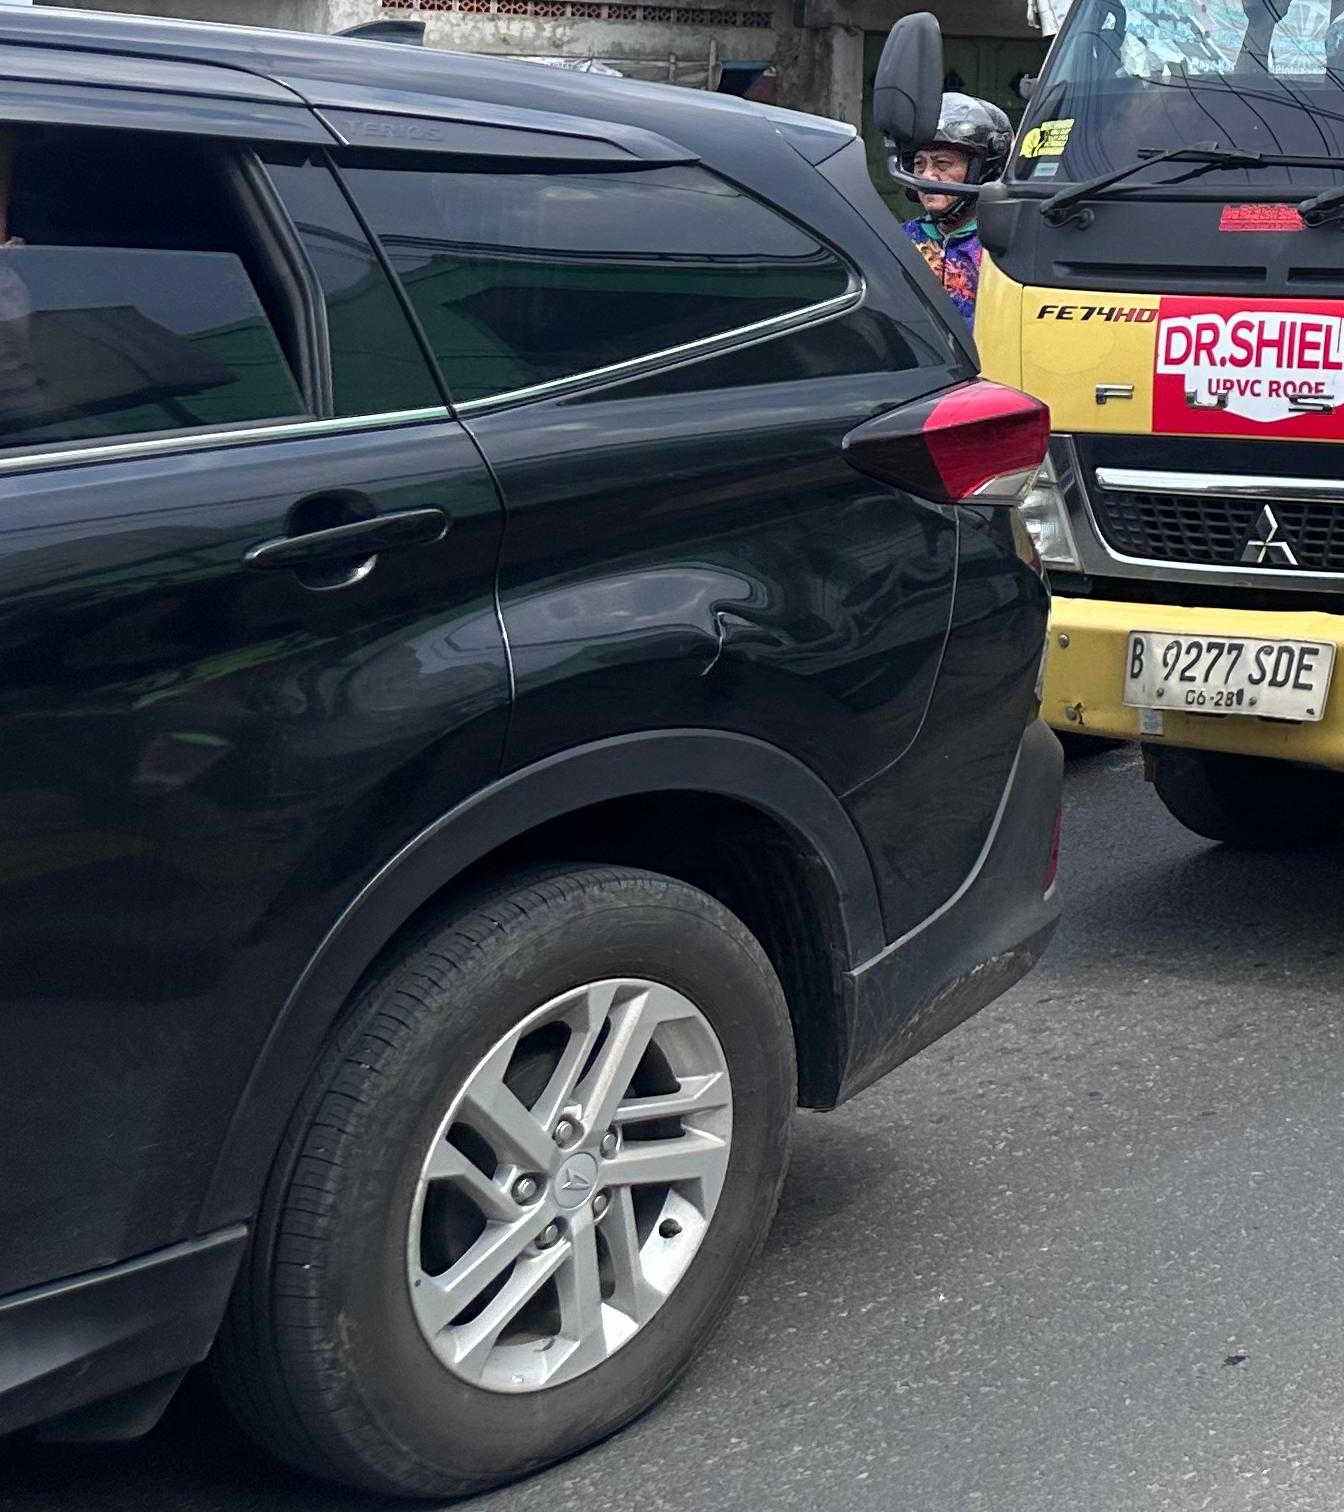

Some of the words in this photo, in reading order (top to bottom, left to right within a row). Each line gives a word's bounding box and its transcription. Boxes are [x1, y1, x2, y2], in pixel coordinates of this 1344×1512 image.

[1036, 304, 1159, 324] FE74HD
[1130, 637, 1145, 680] B
[1162, 639, 1246, 685] 9277
[1248, 644, 1320, 692] SDE
